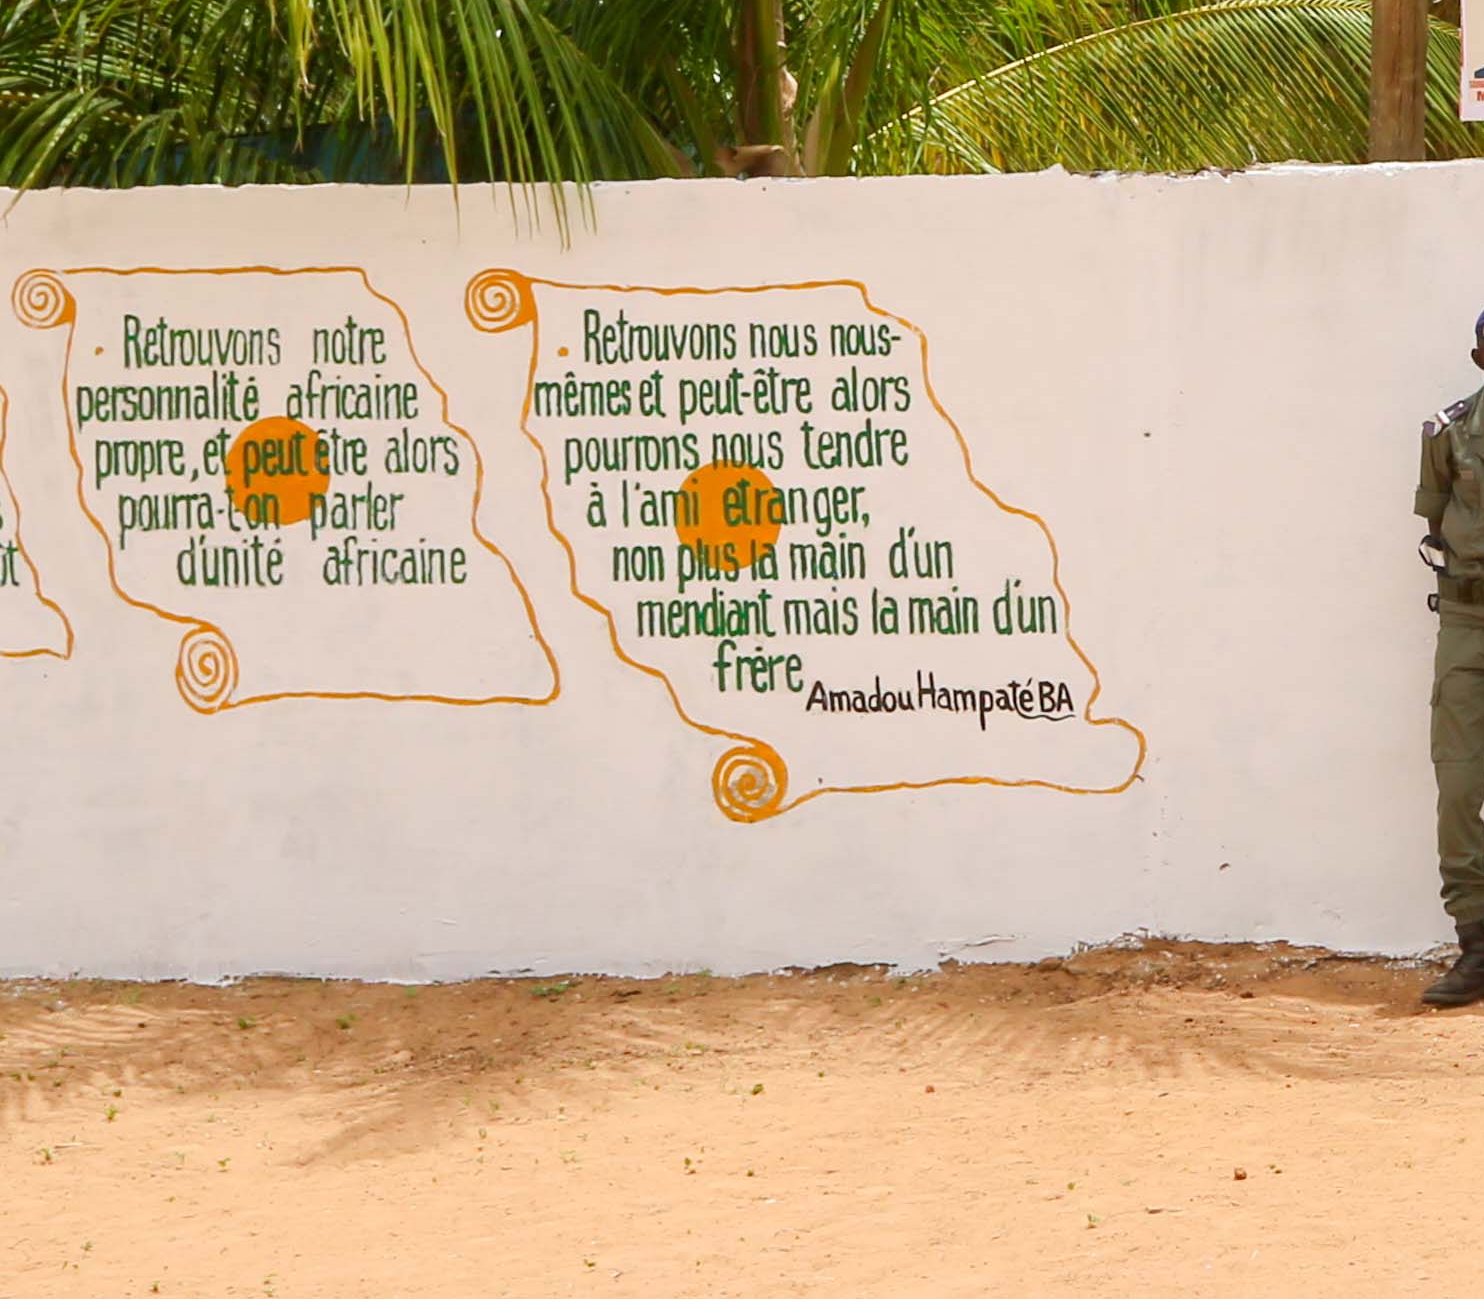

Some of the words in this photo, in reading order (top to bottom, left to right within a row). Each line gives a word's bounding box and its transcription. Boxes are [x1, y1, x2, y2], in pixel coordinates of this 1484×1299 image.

[123, 314, 280, 368] Retrouvons
[314, 316, 387, 365] notre
[583, 308, 737, 365] Retrouvons
[750, 323, 818, 359] nous
[831, 324, 900, 357] nous-
[76, 370, 260, 433] personnalité
[287, 369, 418, 420] africaine
[534, 371, 632, 417] mêmes
[639, 369, 666, 418] et
[679, 367, 815, 429] peut-être
[831, 366, 911, 413] alors
[203, 428, 231, 476] et
[242, 431, 308, 489] peut
[384, 427, 459, 476] alors
[565, 433, 700, 489] pourrons
[711, 430, 784, 471] nous
[801, 418, 909, 470] tendre
[310, 482, 403, 543] parler
[586, 482, 607, 528] à
[621, 479, 700, 528] l'ami
[323, 535, 467, 586] africaine
[613, 545, 665, 582] non
[677, 543, 740, 597] plus
[750, 543, 779, 581] la
[789, 529, 866, 581] main
[889, 526, 953, 578] d'un
[637, 583, 777, 643] mendiant
[782, 586, 860, 637] mais
[871, 588, 899, 635] la
[909, 585, 980, 635] main
[993, 579, 1057, 636] d'un
[803, 674, 916, 716] Amadou
[917, 669, 1034, 731] Hampaté
[1038, 680, 1075, 713] BA
